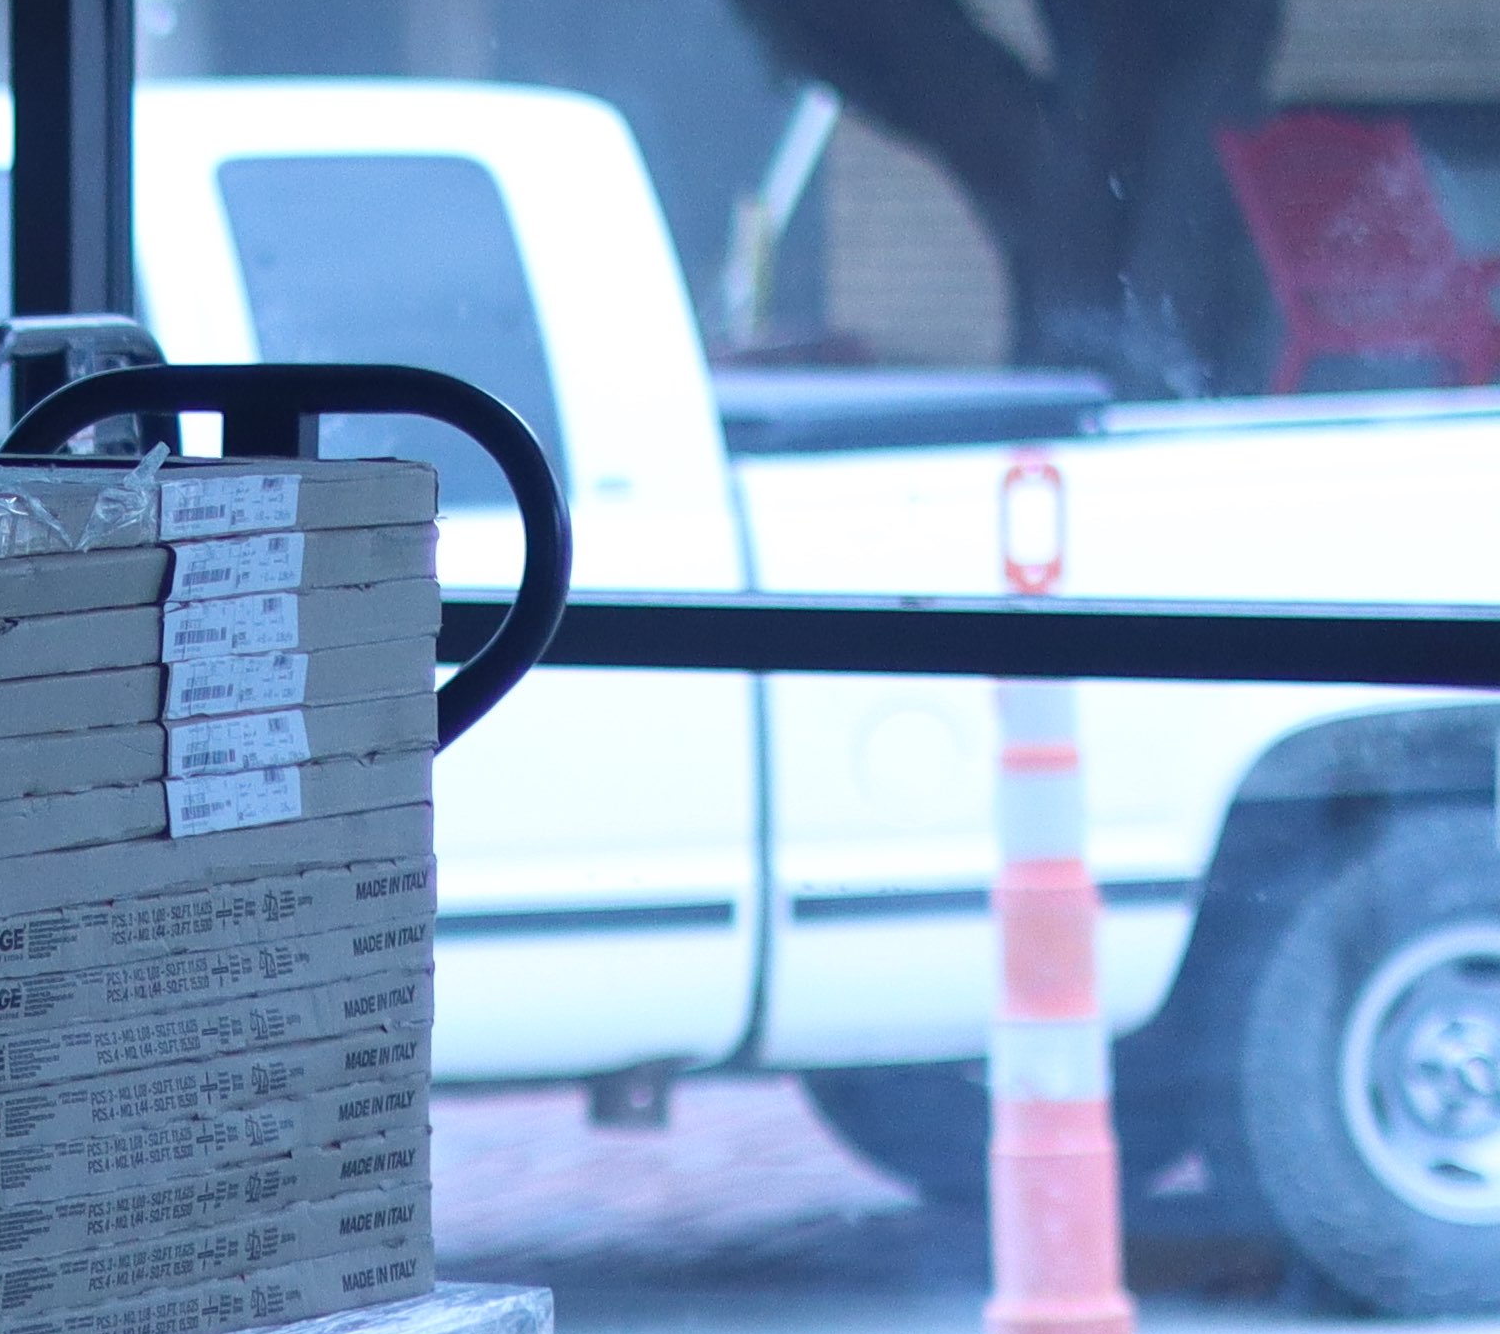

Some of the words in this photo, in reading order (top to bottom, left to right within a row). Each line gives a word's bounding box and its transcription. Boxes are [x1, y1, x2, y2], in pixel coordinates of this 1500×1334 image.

[356, 878, 387, 900] MADE
[389, 876, 400, 894] IN
[402, 869, 428, 892] ITALY
[353, 933, 383, 956] MADE
[384, 929, 396, 950] IN
[398, 924, 426, 946] ITALY
[344, 995, 375, 1019] MADE
[377, 992, 388, 1011] IN
[389, 984, 415, 1008] ITALY
[345, 1048, 377, 1070] MADE
[379, 1046, 390, 1066] IN
[391, 1041, 417, 1062] ITALY
[338, 1098, 370, 1121] MADE
[371, 1095, 383, 1114] IN
[385, 1090, 415, 1111] ITALY
[341, 1156, 372, 1179] MADE
[373, 1153, 385, 1172] IN
[386, 1148, 416, 1170] ITALY
[339, 1212, 372, 1235] MADE
[373, 1210, 386, 1228] IN
[387, 1203, 415, 1226] ITALY
[342, 1269, 374, 1292] MADE
[376, 1265, 388, 1285] IN
[389, 1258, 417, 1282] ITALY
